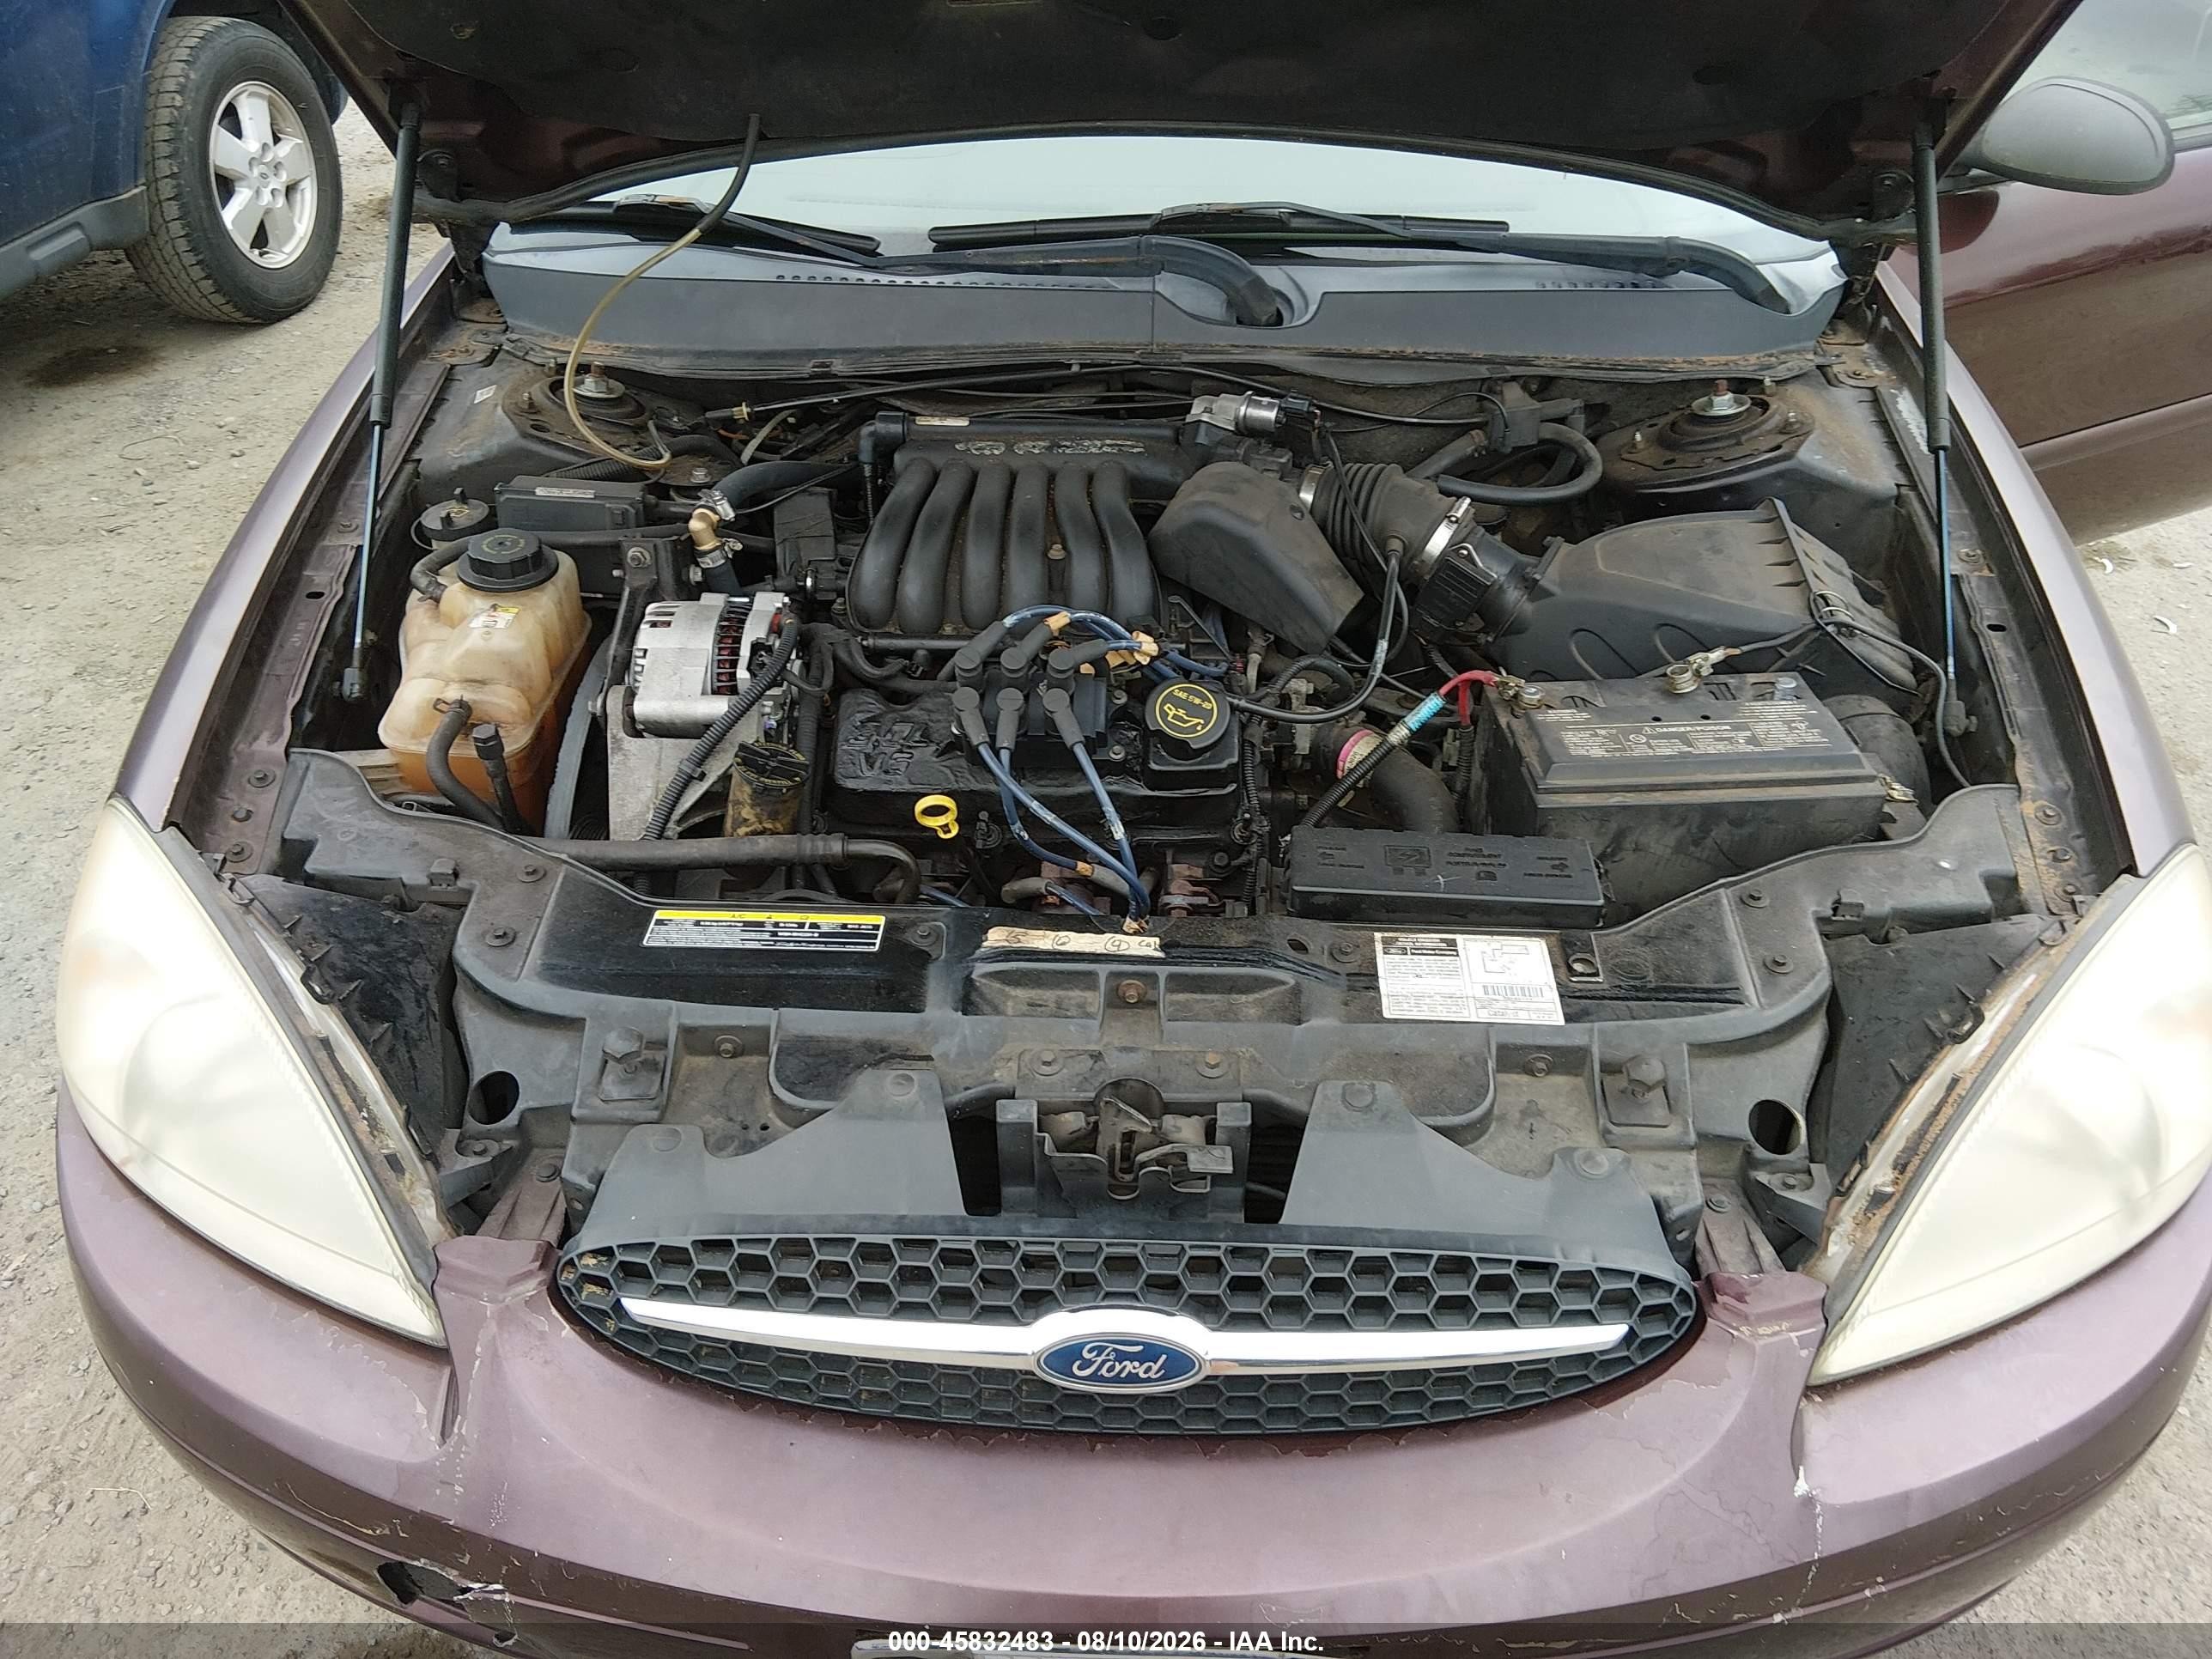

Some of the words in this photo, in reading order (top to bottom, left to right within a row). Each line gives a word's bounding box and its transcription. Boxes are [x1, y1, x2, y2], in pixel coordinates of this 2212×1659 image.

[1172, 689, 1189, 701] SAE
[1188, 695, 1212, 709] 5W-20
[1072, 1342, 1168, 1379] Ford
